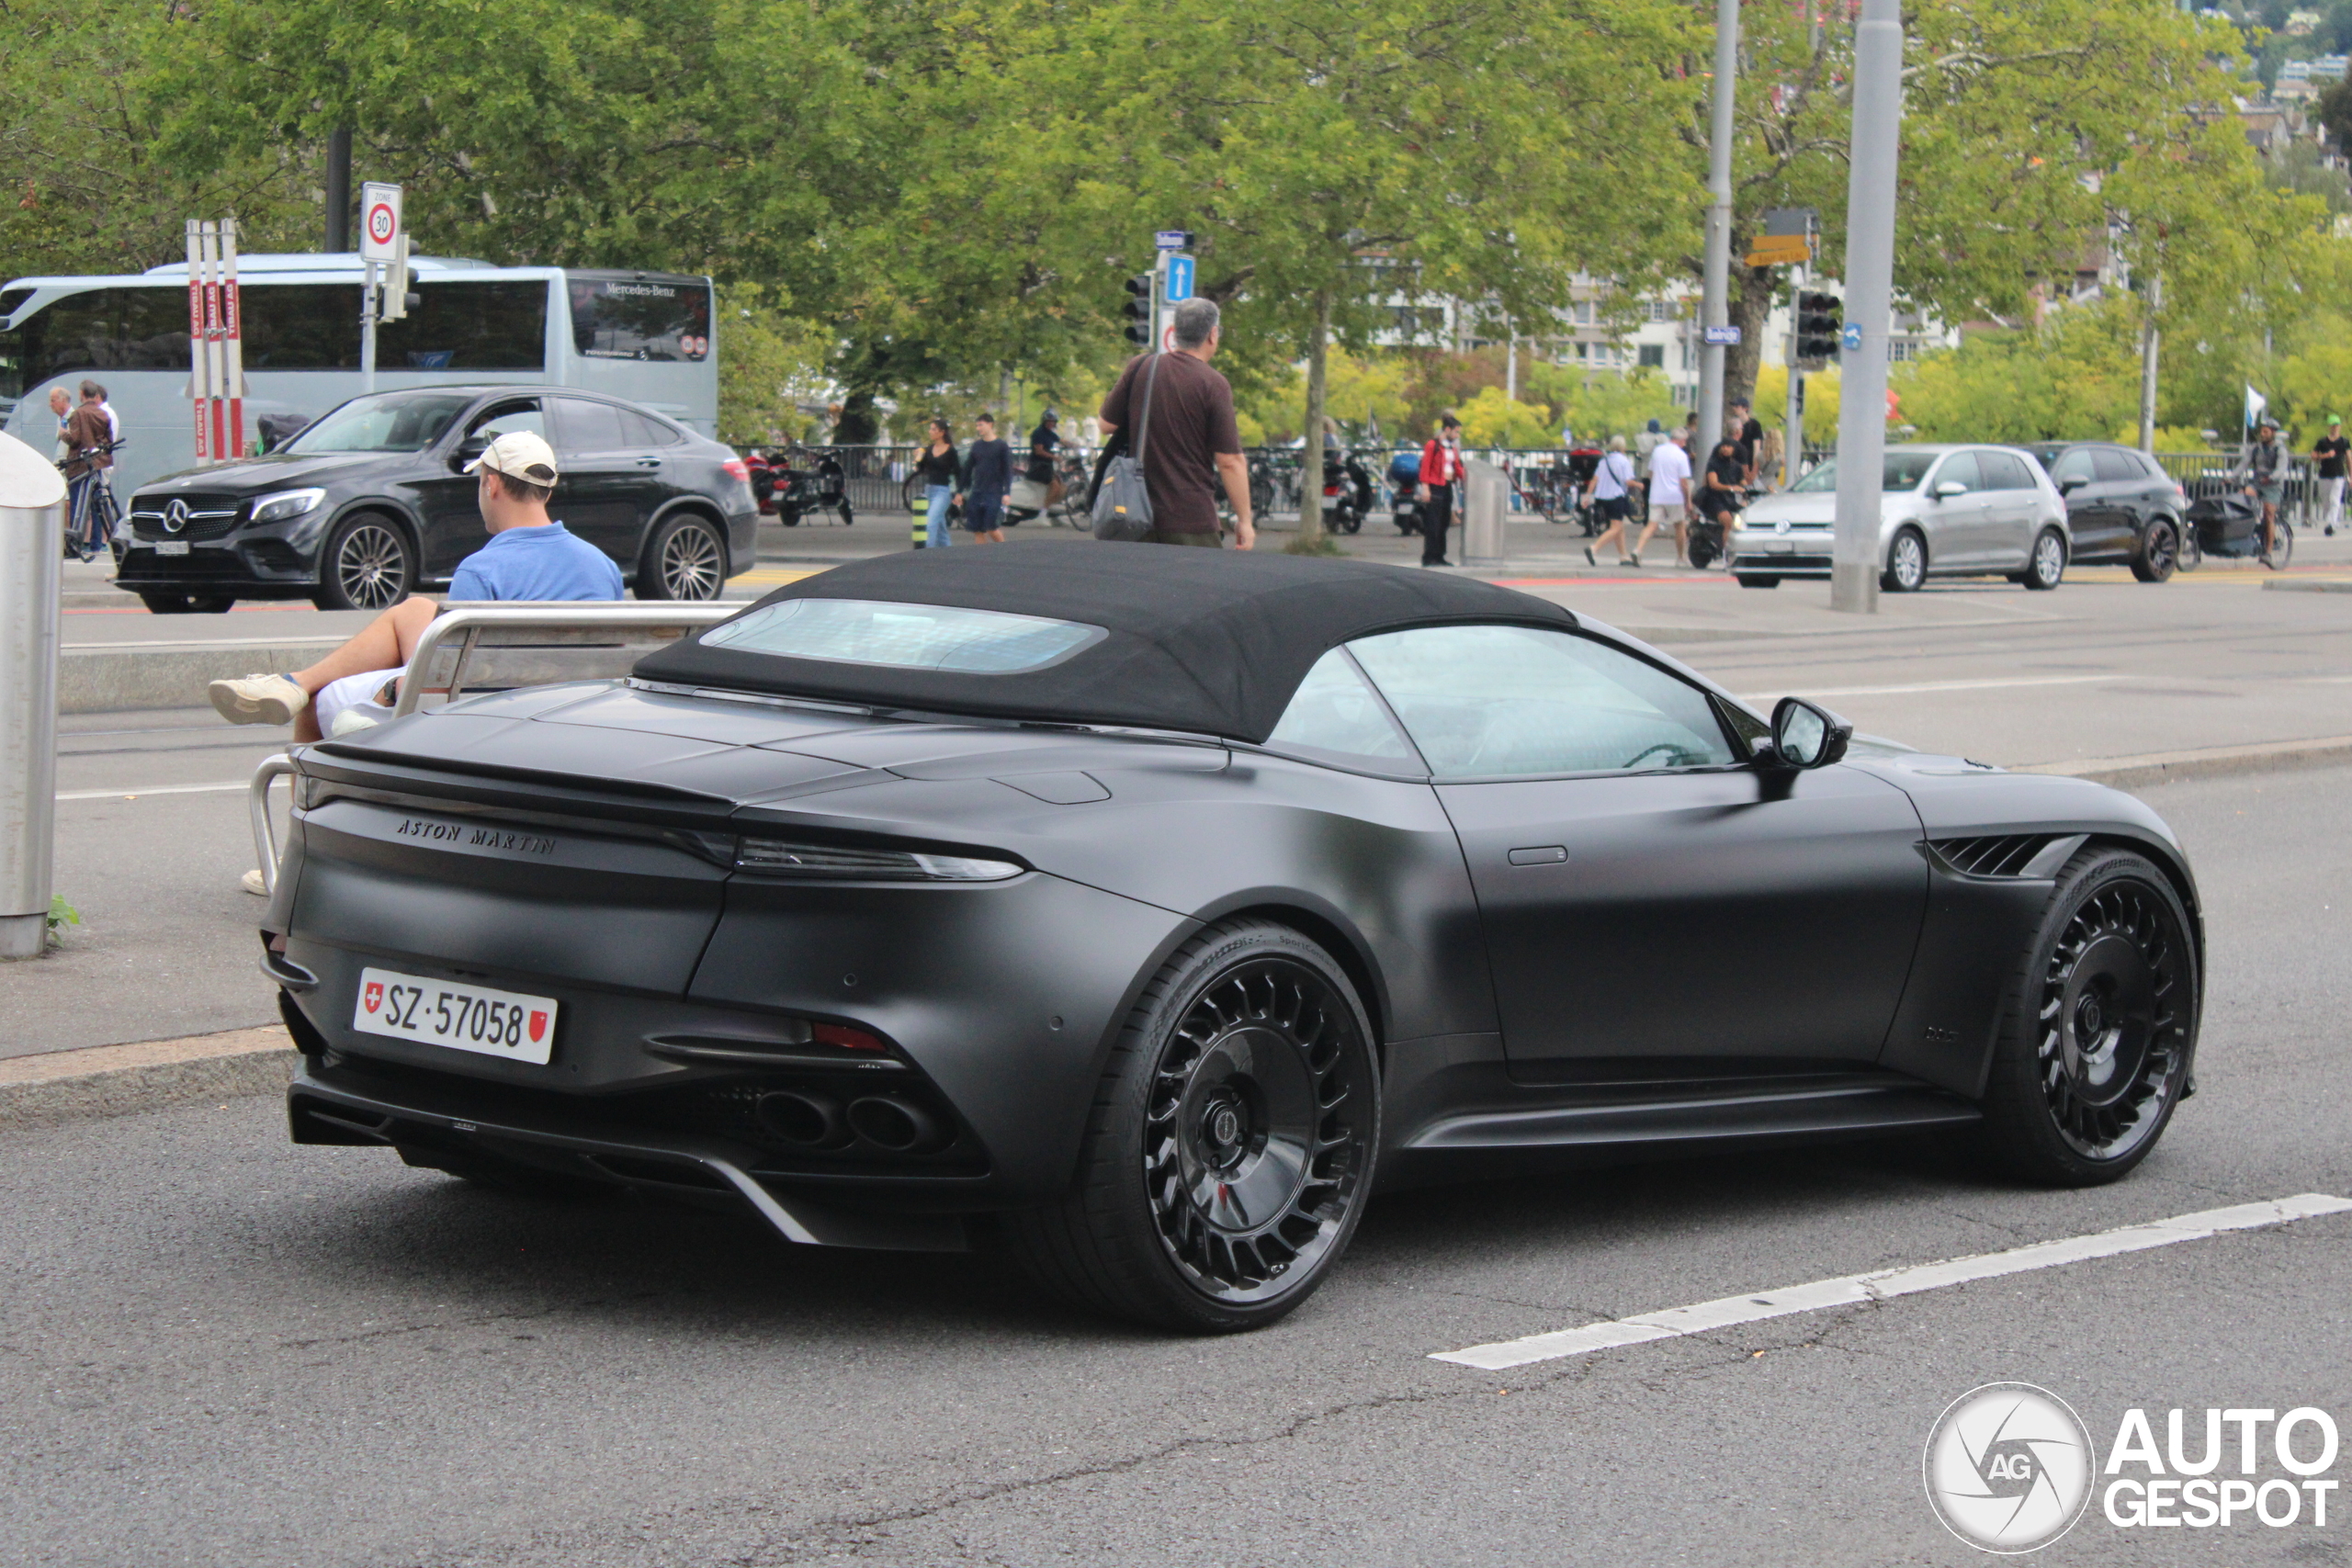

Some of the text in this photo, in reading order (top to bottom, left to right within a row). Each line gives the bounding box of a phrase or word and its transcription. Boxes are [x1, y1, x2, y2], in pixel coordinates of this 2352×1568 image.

[375, 192, 391, 203] ZONE
[375, 216, 388, 232] 30
[208, 286, 216, 302] AG
[606, 282, 675, 298] Mercedes-Benz
[191, 285, 200, 336] TIBAU AG
[226, 283, 236, 335] TIBAU AG
[584, 349, 635, 357] TOURISMO
[197, 437, 205, 453] AG
[397, 819, 556, 854] ASTON MARTIN
